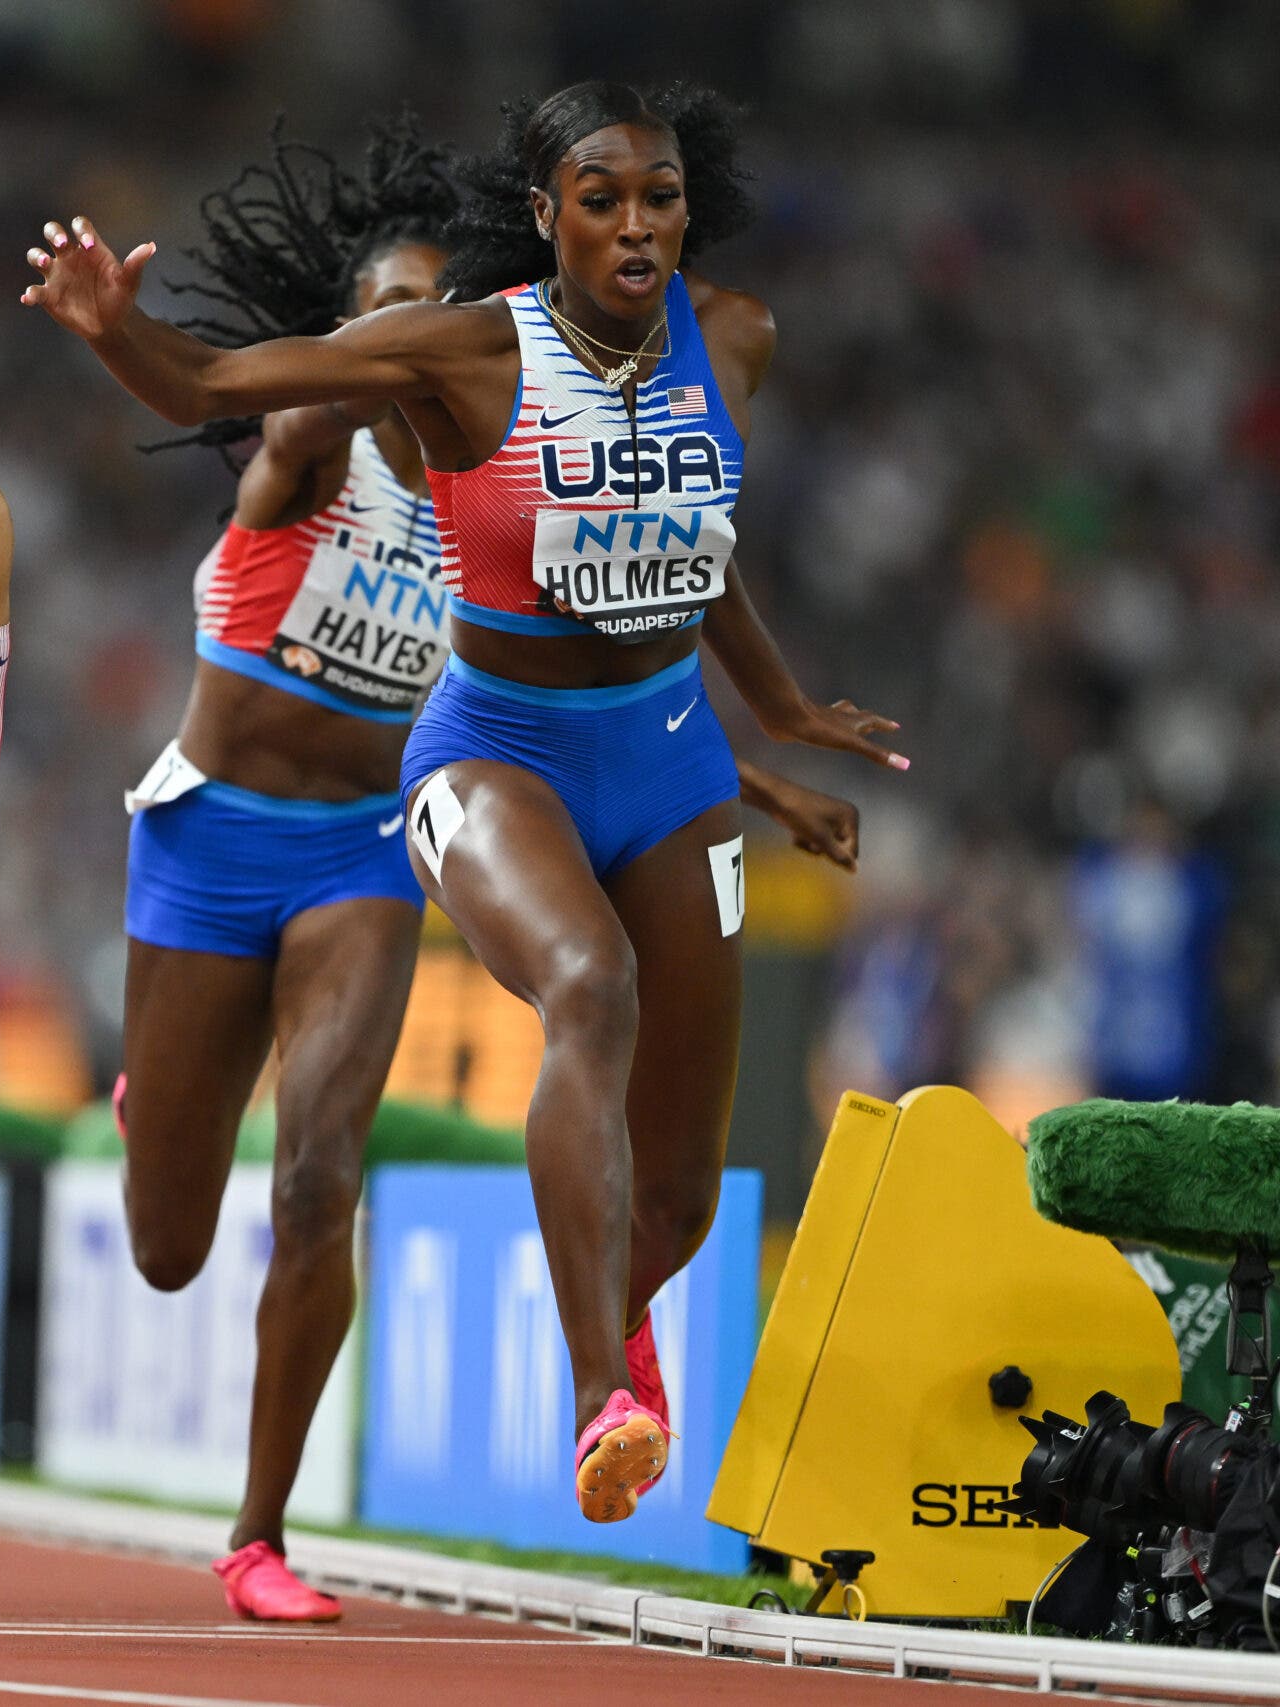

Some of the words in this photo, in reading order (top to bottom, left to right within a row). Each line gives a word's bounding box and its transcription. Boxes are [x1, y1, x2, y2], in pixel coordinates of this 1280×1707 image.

[540, 434, 722, 499] USA
[573, 511, 702, 554] NTN
[343, 560, 447, 632] NTN
[545, 555, 714, 606] HOLMES
[310, 606, 436, 676] HAYES
[417, 798, 439, 860] 7
[848, 1099, 886, 1117] SEIKO
